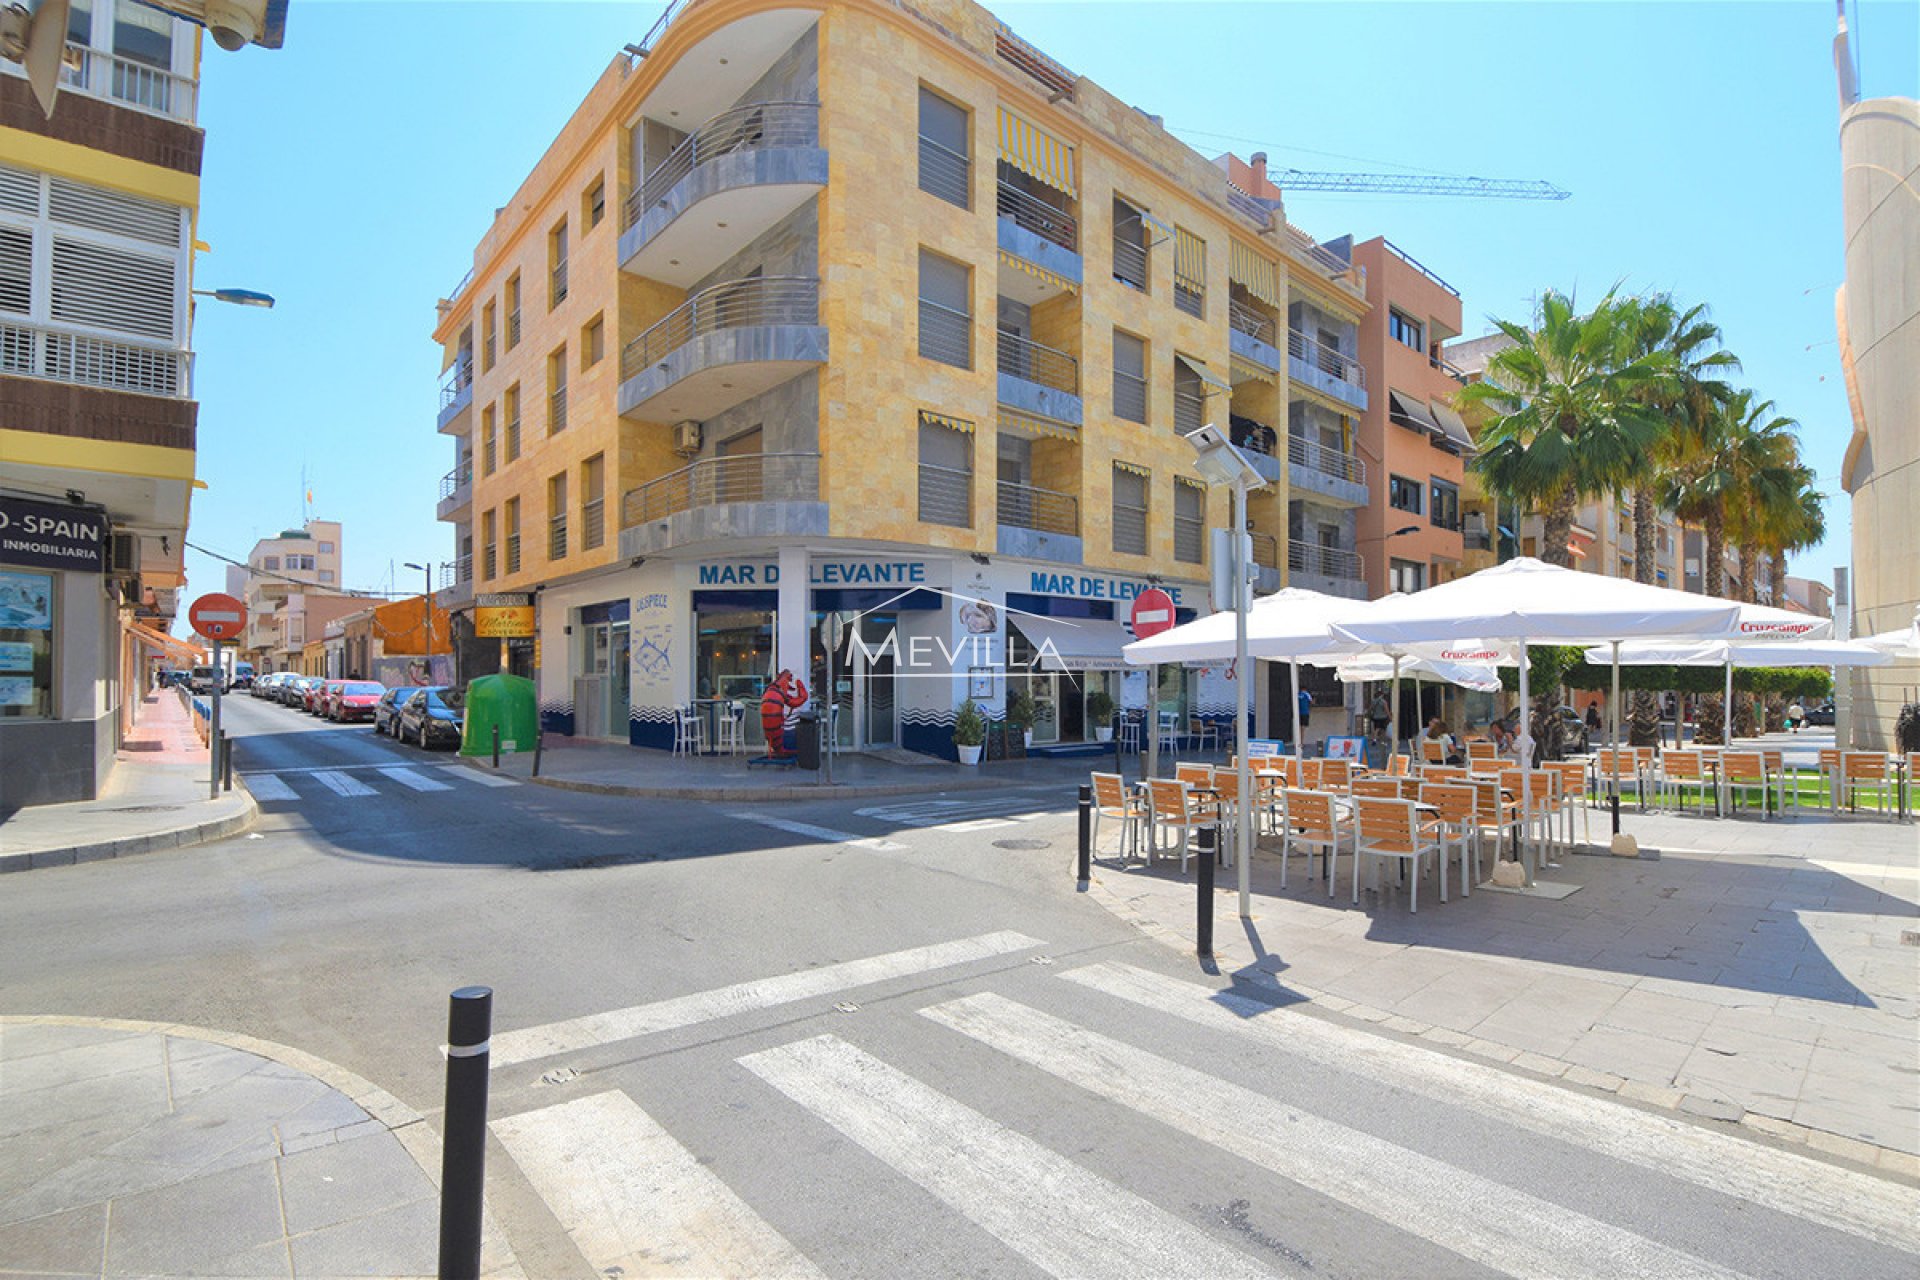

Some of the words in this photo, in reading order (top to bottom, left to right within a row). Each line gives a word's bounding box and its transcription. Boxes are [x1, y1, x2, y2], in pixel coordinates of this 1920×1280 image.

[3, 539, 97, 559] INMOBILIARIA
[699, 564, 756, 584] MAR
[765, 564, 780, 584] D
[810, 562, 925, 583] LEVANTE
[1031, 572, 1076, 595] MAR
[1080, 577, 1105, 598] DE
[1110, 580, 1183, 605] LEVTE
[1740, 622, 1814, 634] Cruzcampo
[1441, 650, 1499, 660] Cruzcampo
